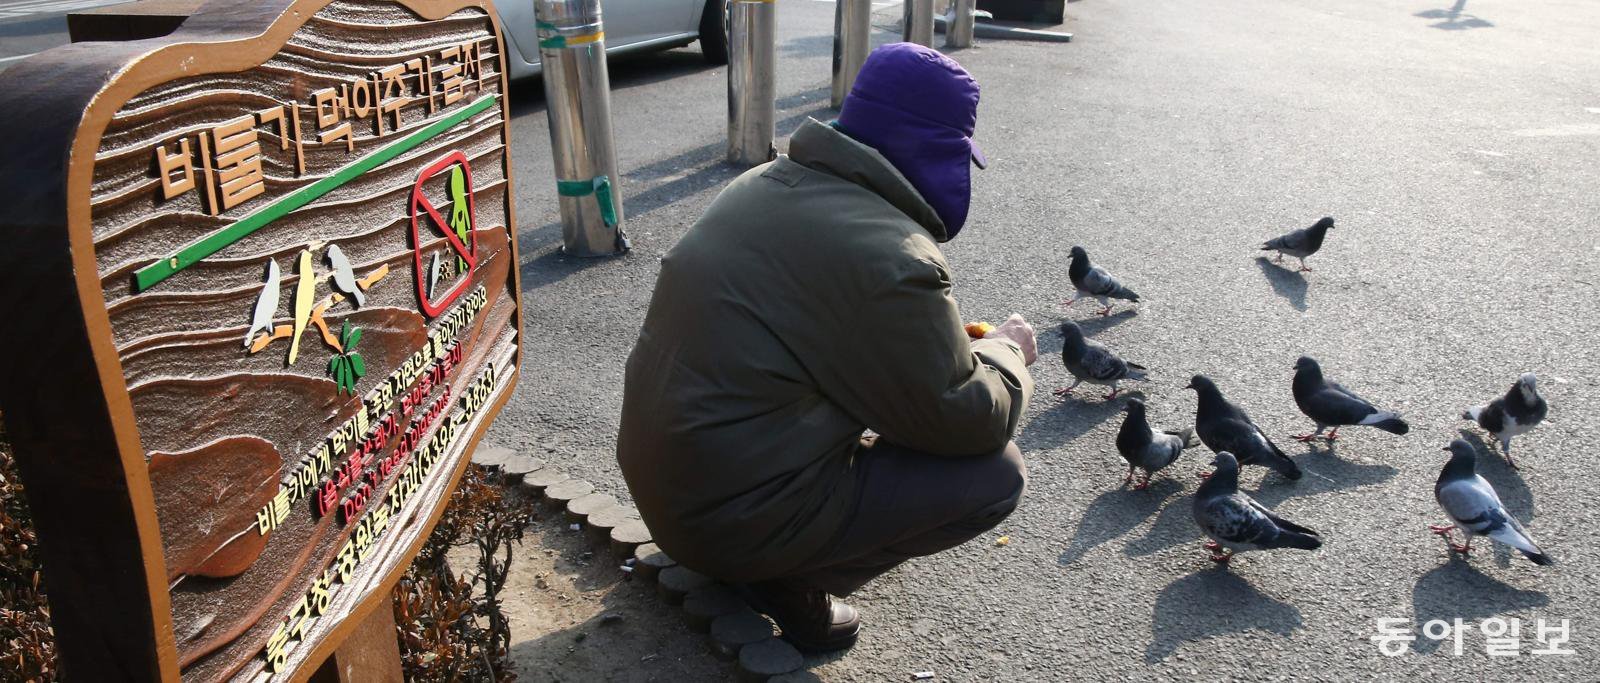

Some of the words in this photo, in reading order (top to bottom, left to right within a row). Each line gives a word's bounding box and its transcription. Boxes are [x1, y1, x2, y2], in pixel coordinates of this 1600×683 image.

[157, 100, 306, 217] 비둘기
[314, 55, 437, 151] 먹이주기
[441, 40, 482, 105] 금지
[256, 445, 331, 536] 비둘기에게
[333, 405, 369, 455] 먹이를
[370, 382, 393, 418] 주면
[395, 341, 432, 394] 자연으로
[434, 308, 465, 358] 돌아가지
[466, 286, 487, 323] 않아요
[402, 363, 441, 416] 먹이주기
[382, 436, 407, 480] feed
[266, 569, 330, 674] 중구청
